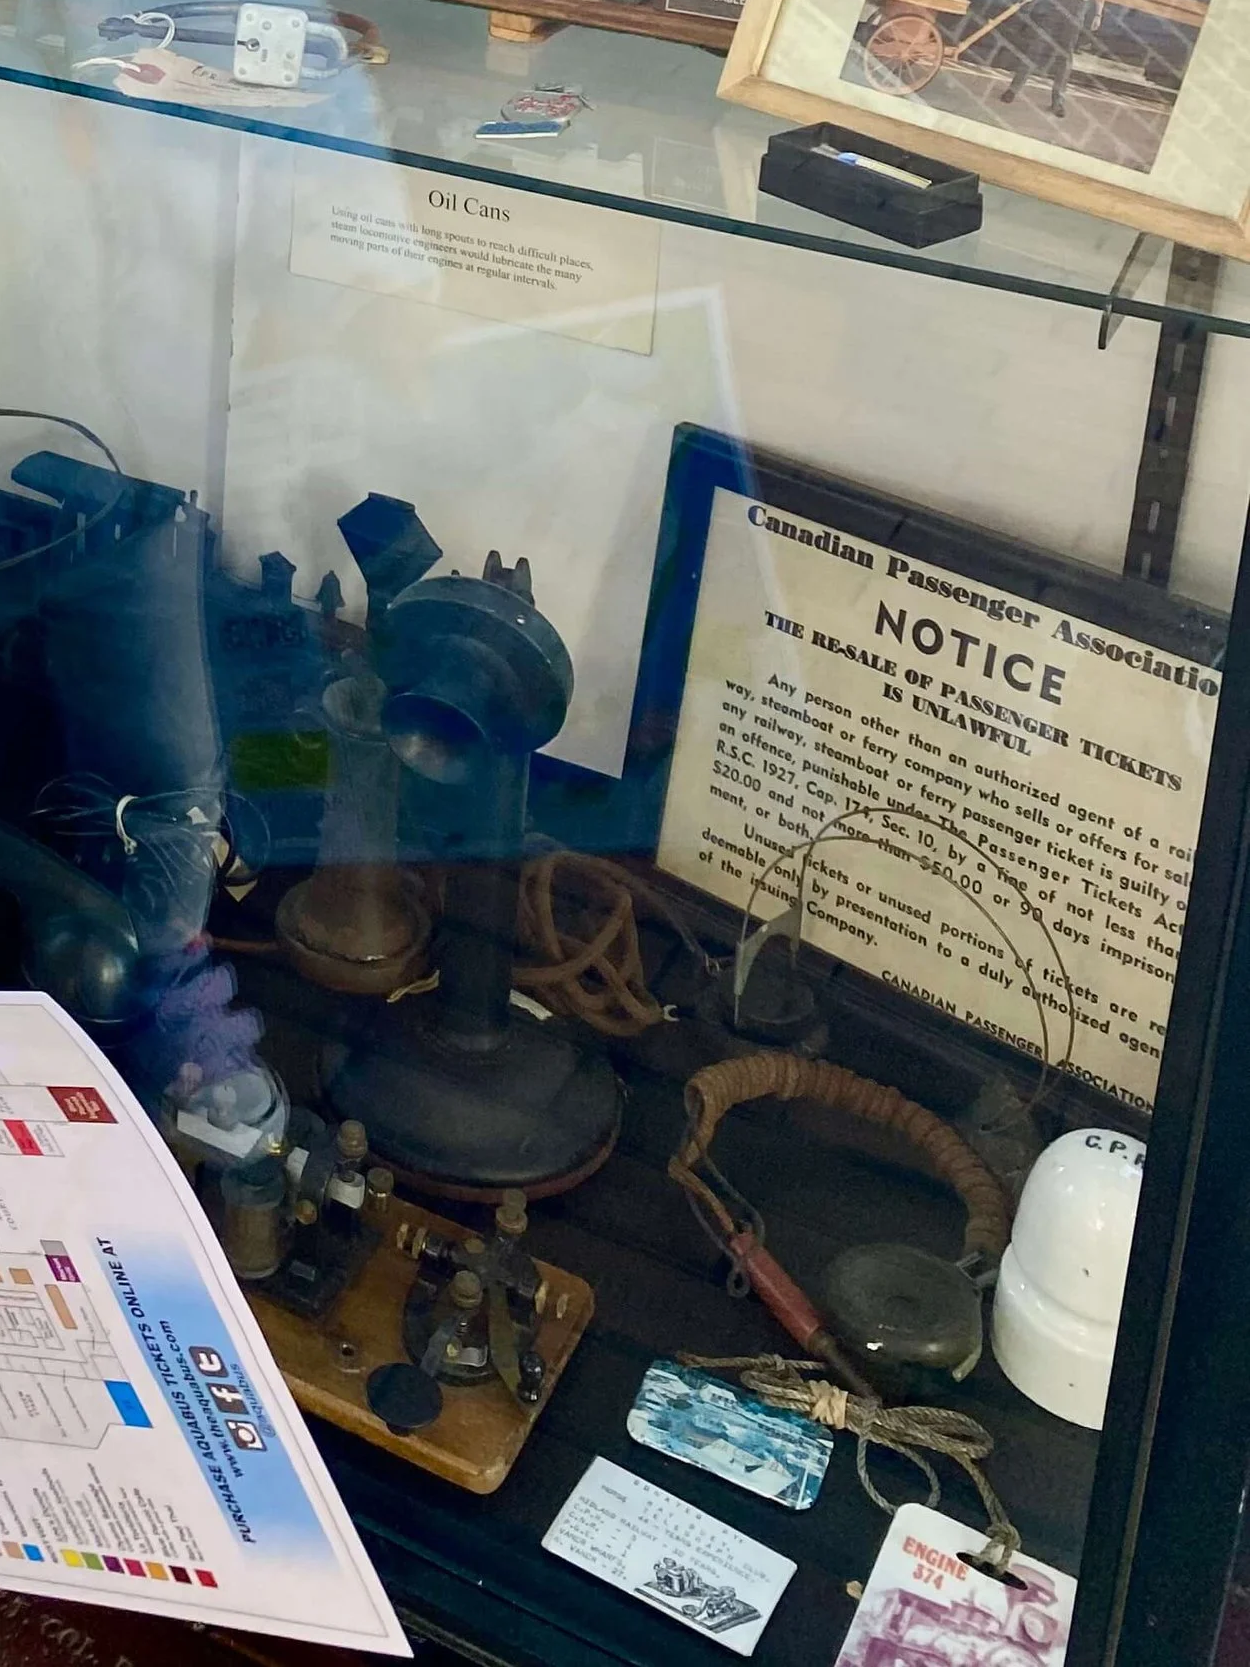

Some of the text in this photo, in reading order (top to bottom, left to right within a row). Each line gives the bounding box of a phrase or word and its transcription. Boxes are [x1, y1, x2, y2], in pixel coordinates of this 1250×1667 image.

[428, 190, 509, 220] Oil Cans
[747, 505, 1219, 697] Canadian Passenger Associatio
[874, 599, 1065, 705] NOTICE
[764, 610, 1181, 791] THE RE-SALE OF PASSENGER TICKETS
[882, 681, 1030, 756] IS UNLAWFUL
[699, 851, 877, 946] of the issuing Company.
[881, 968, 958, 1015] CANADIAN
[965, 1008, 1043, 1059] PASSENGER
[96, 1236, 120, 1257] AT
[108, 1260, 146, 1318] ONLINE
[140, 1322, 178, 1386] TICKETS
[160, 1319, 244, 1479] www.theaquabus.com
[172, 1390, 215, 1462] AQUABUS
[209, 1463, 258, 1544] PURCHASE
[902, 1535, 970, 1582] ENGINE
[912, 1563, 945, 1591] 374
